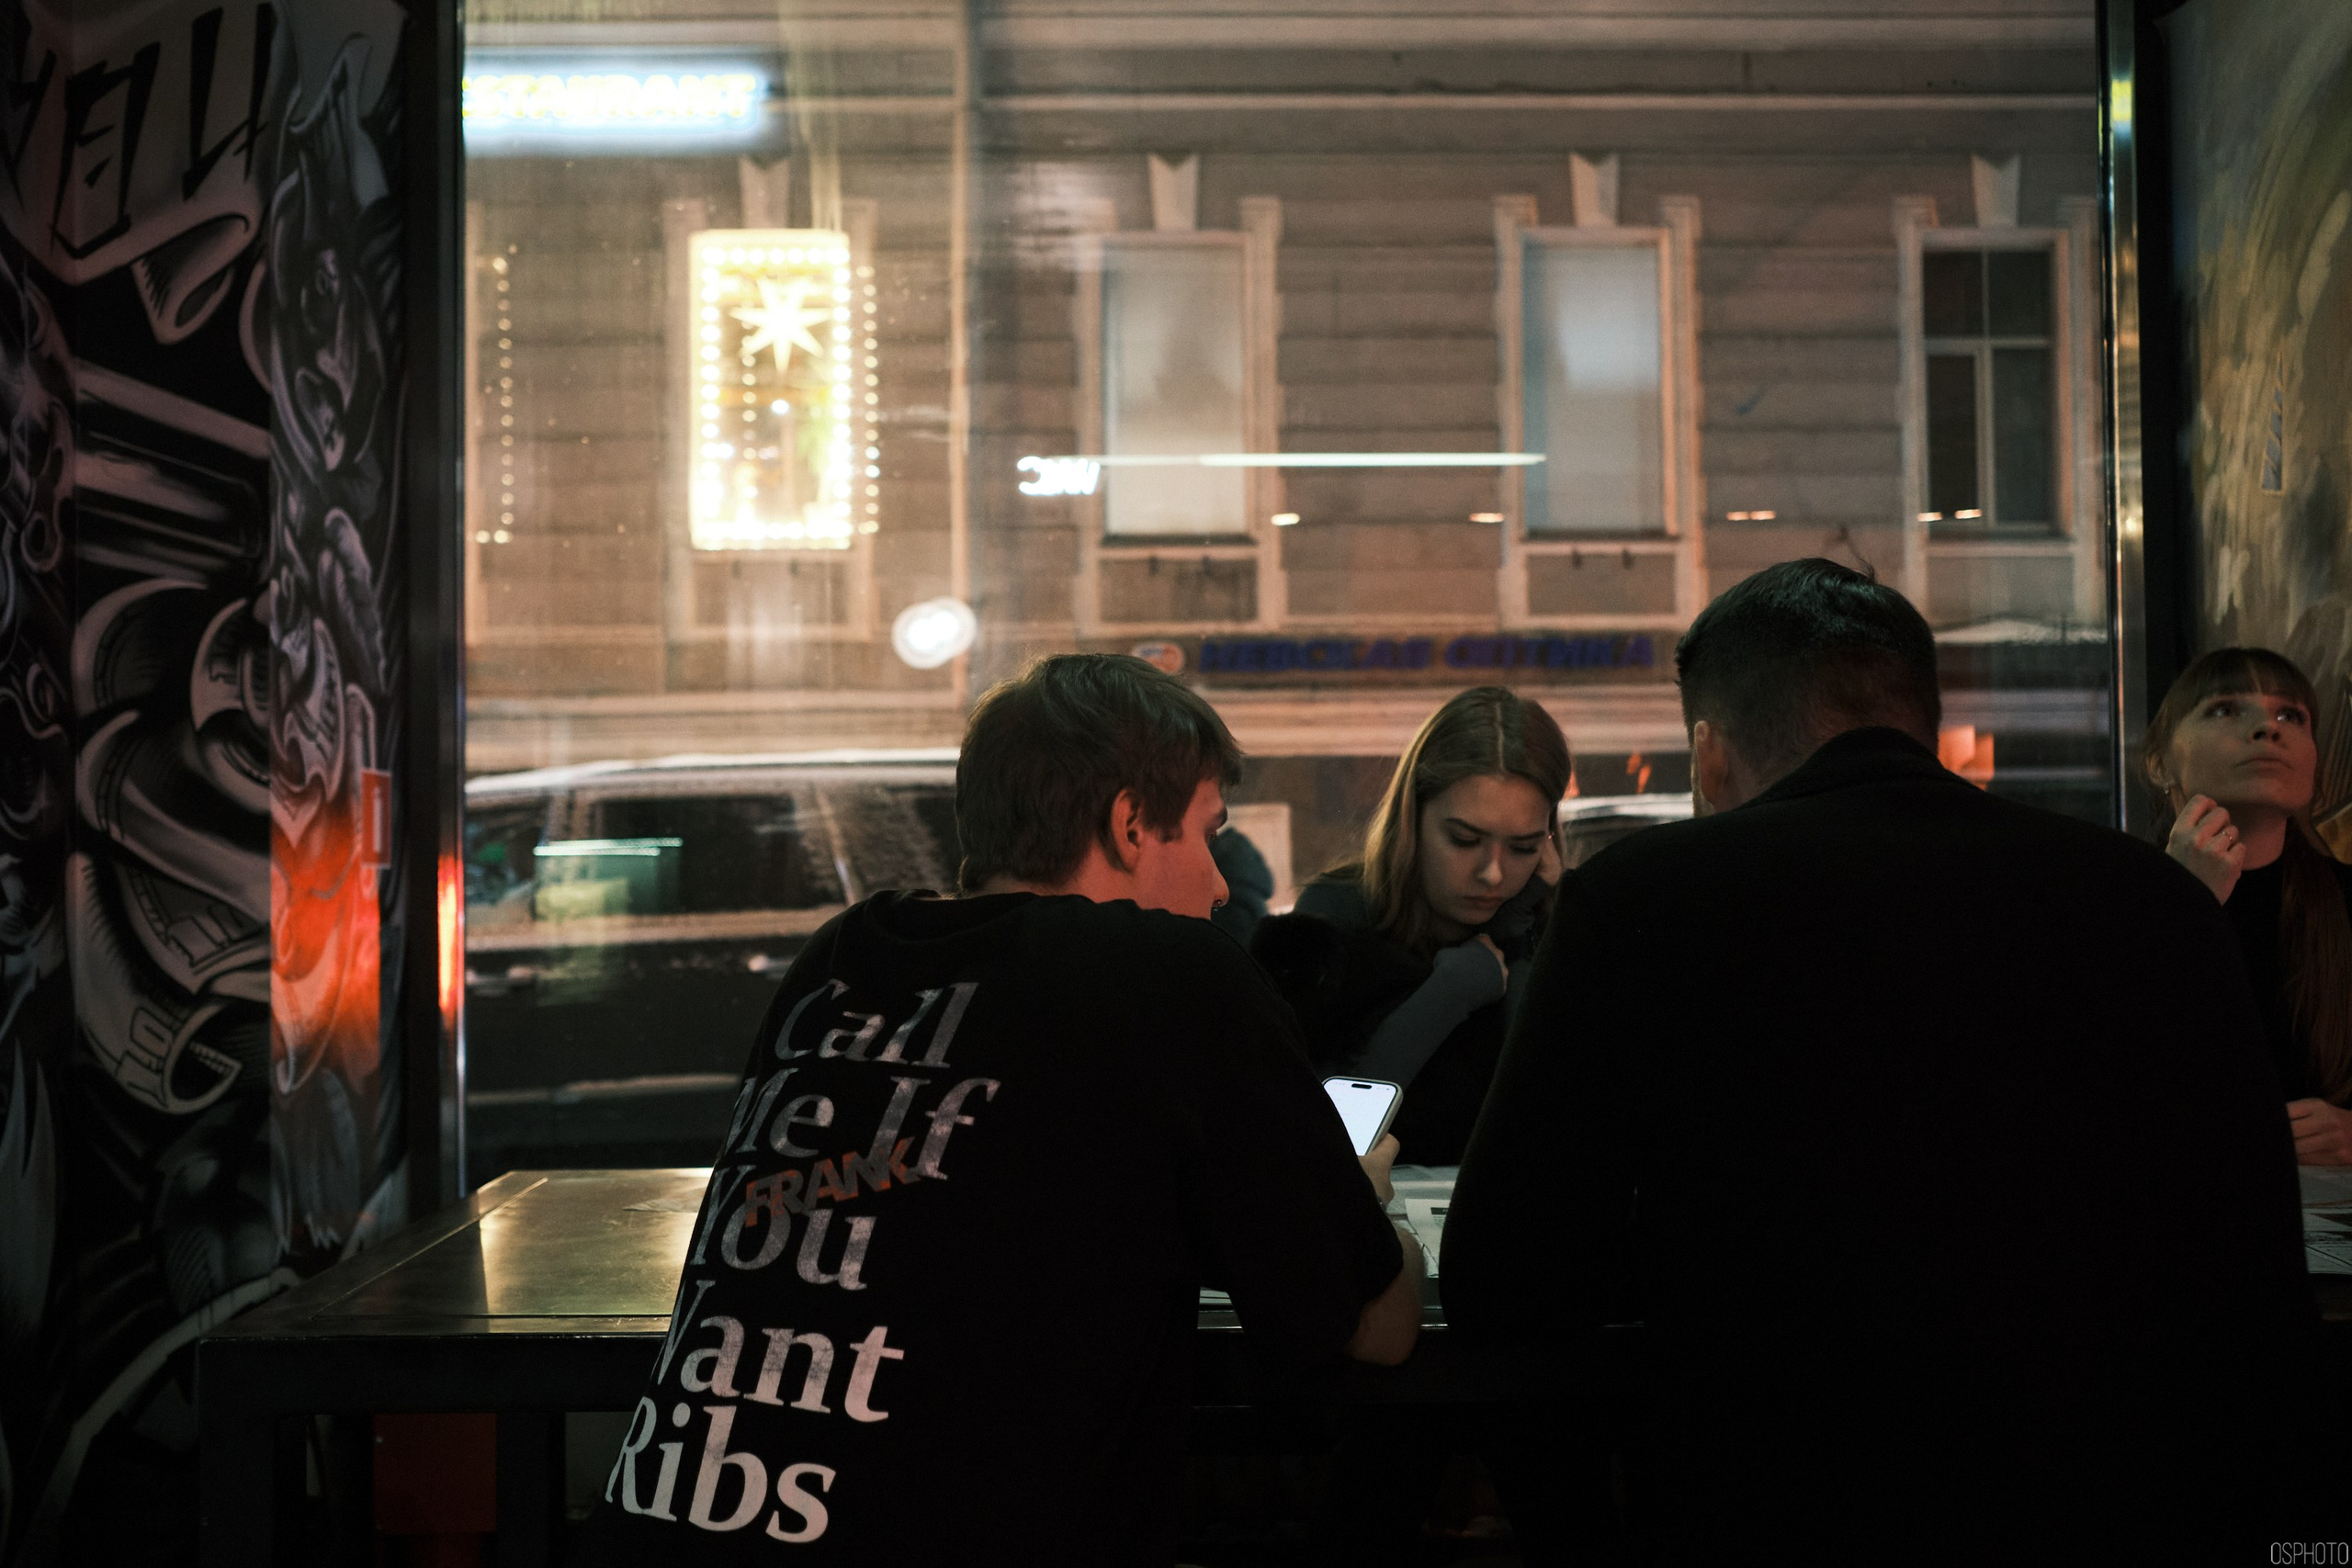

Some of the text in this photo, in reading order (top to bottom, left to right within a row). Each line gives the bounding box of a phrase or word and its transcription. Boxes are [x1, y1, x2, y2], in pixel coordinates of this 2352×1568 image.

[462, 74, 756, 118] STAURANT
[775, 978, 979, 1068] Call
[861, 1077, 1001, 1180] If
[690, 1165, 877, 1291] You
[745, 1137, 920, 1227] FRANK
[605, 1396, 836, 1543] Ribs
